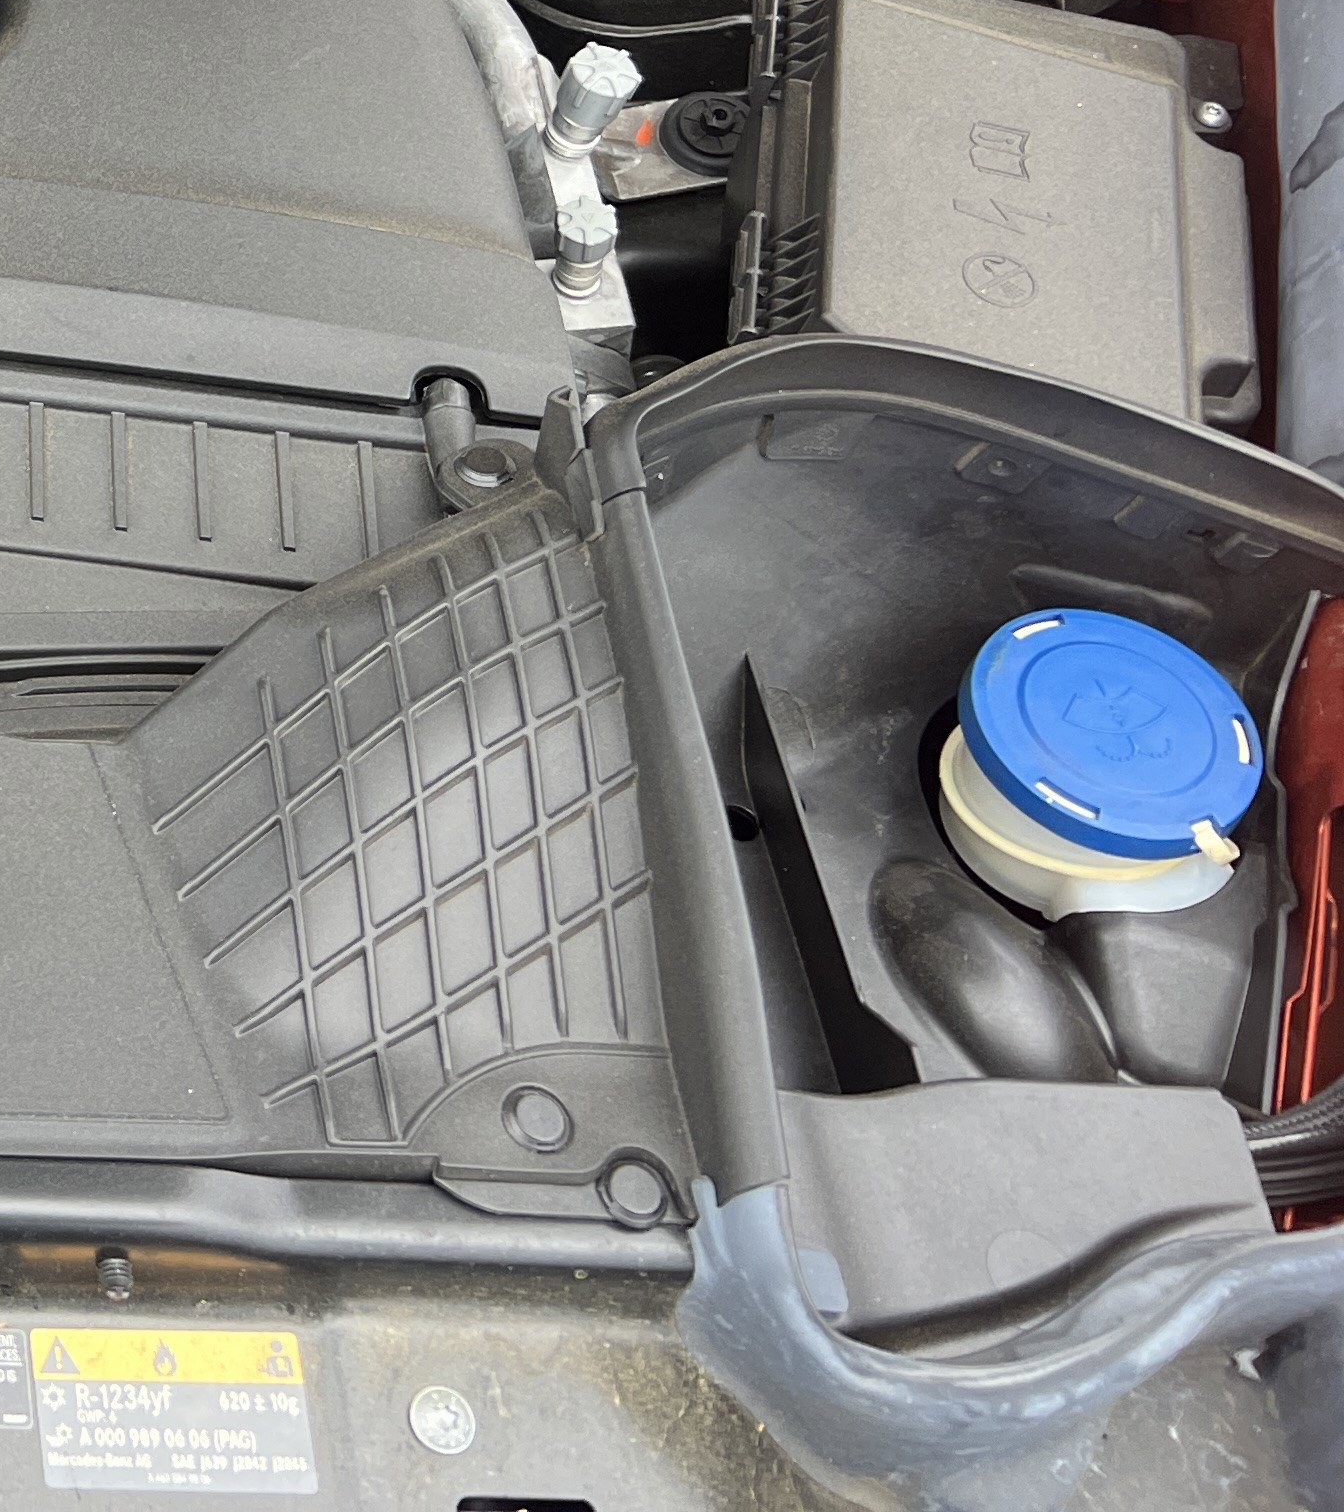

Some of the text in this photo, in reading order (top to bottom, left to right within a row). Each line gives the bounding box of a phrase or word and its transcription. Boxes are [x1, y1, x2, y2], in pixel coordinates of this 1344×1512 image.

[6, 1369, 17, 1383] IS
[74, 1382, 172, 1417] R-1234yf
[219, 1390, 250, 1411] 620
[79, 1426, 257, 1455] A 000 989 06 06 (PAG)
[47, 1450, 133, 1468] Mercedes-Benz
